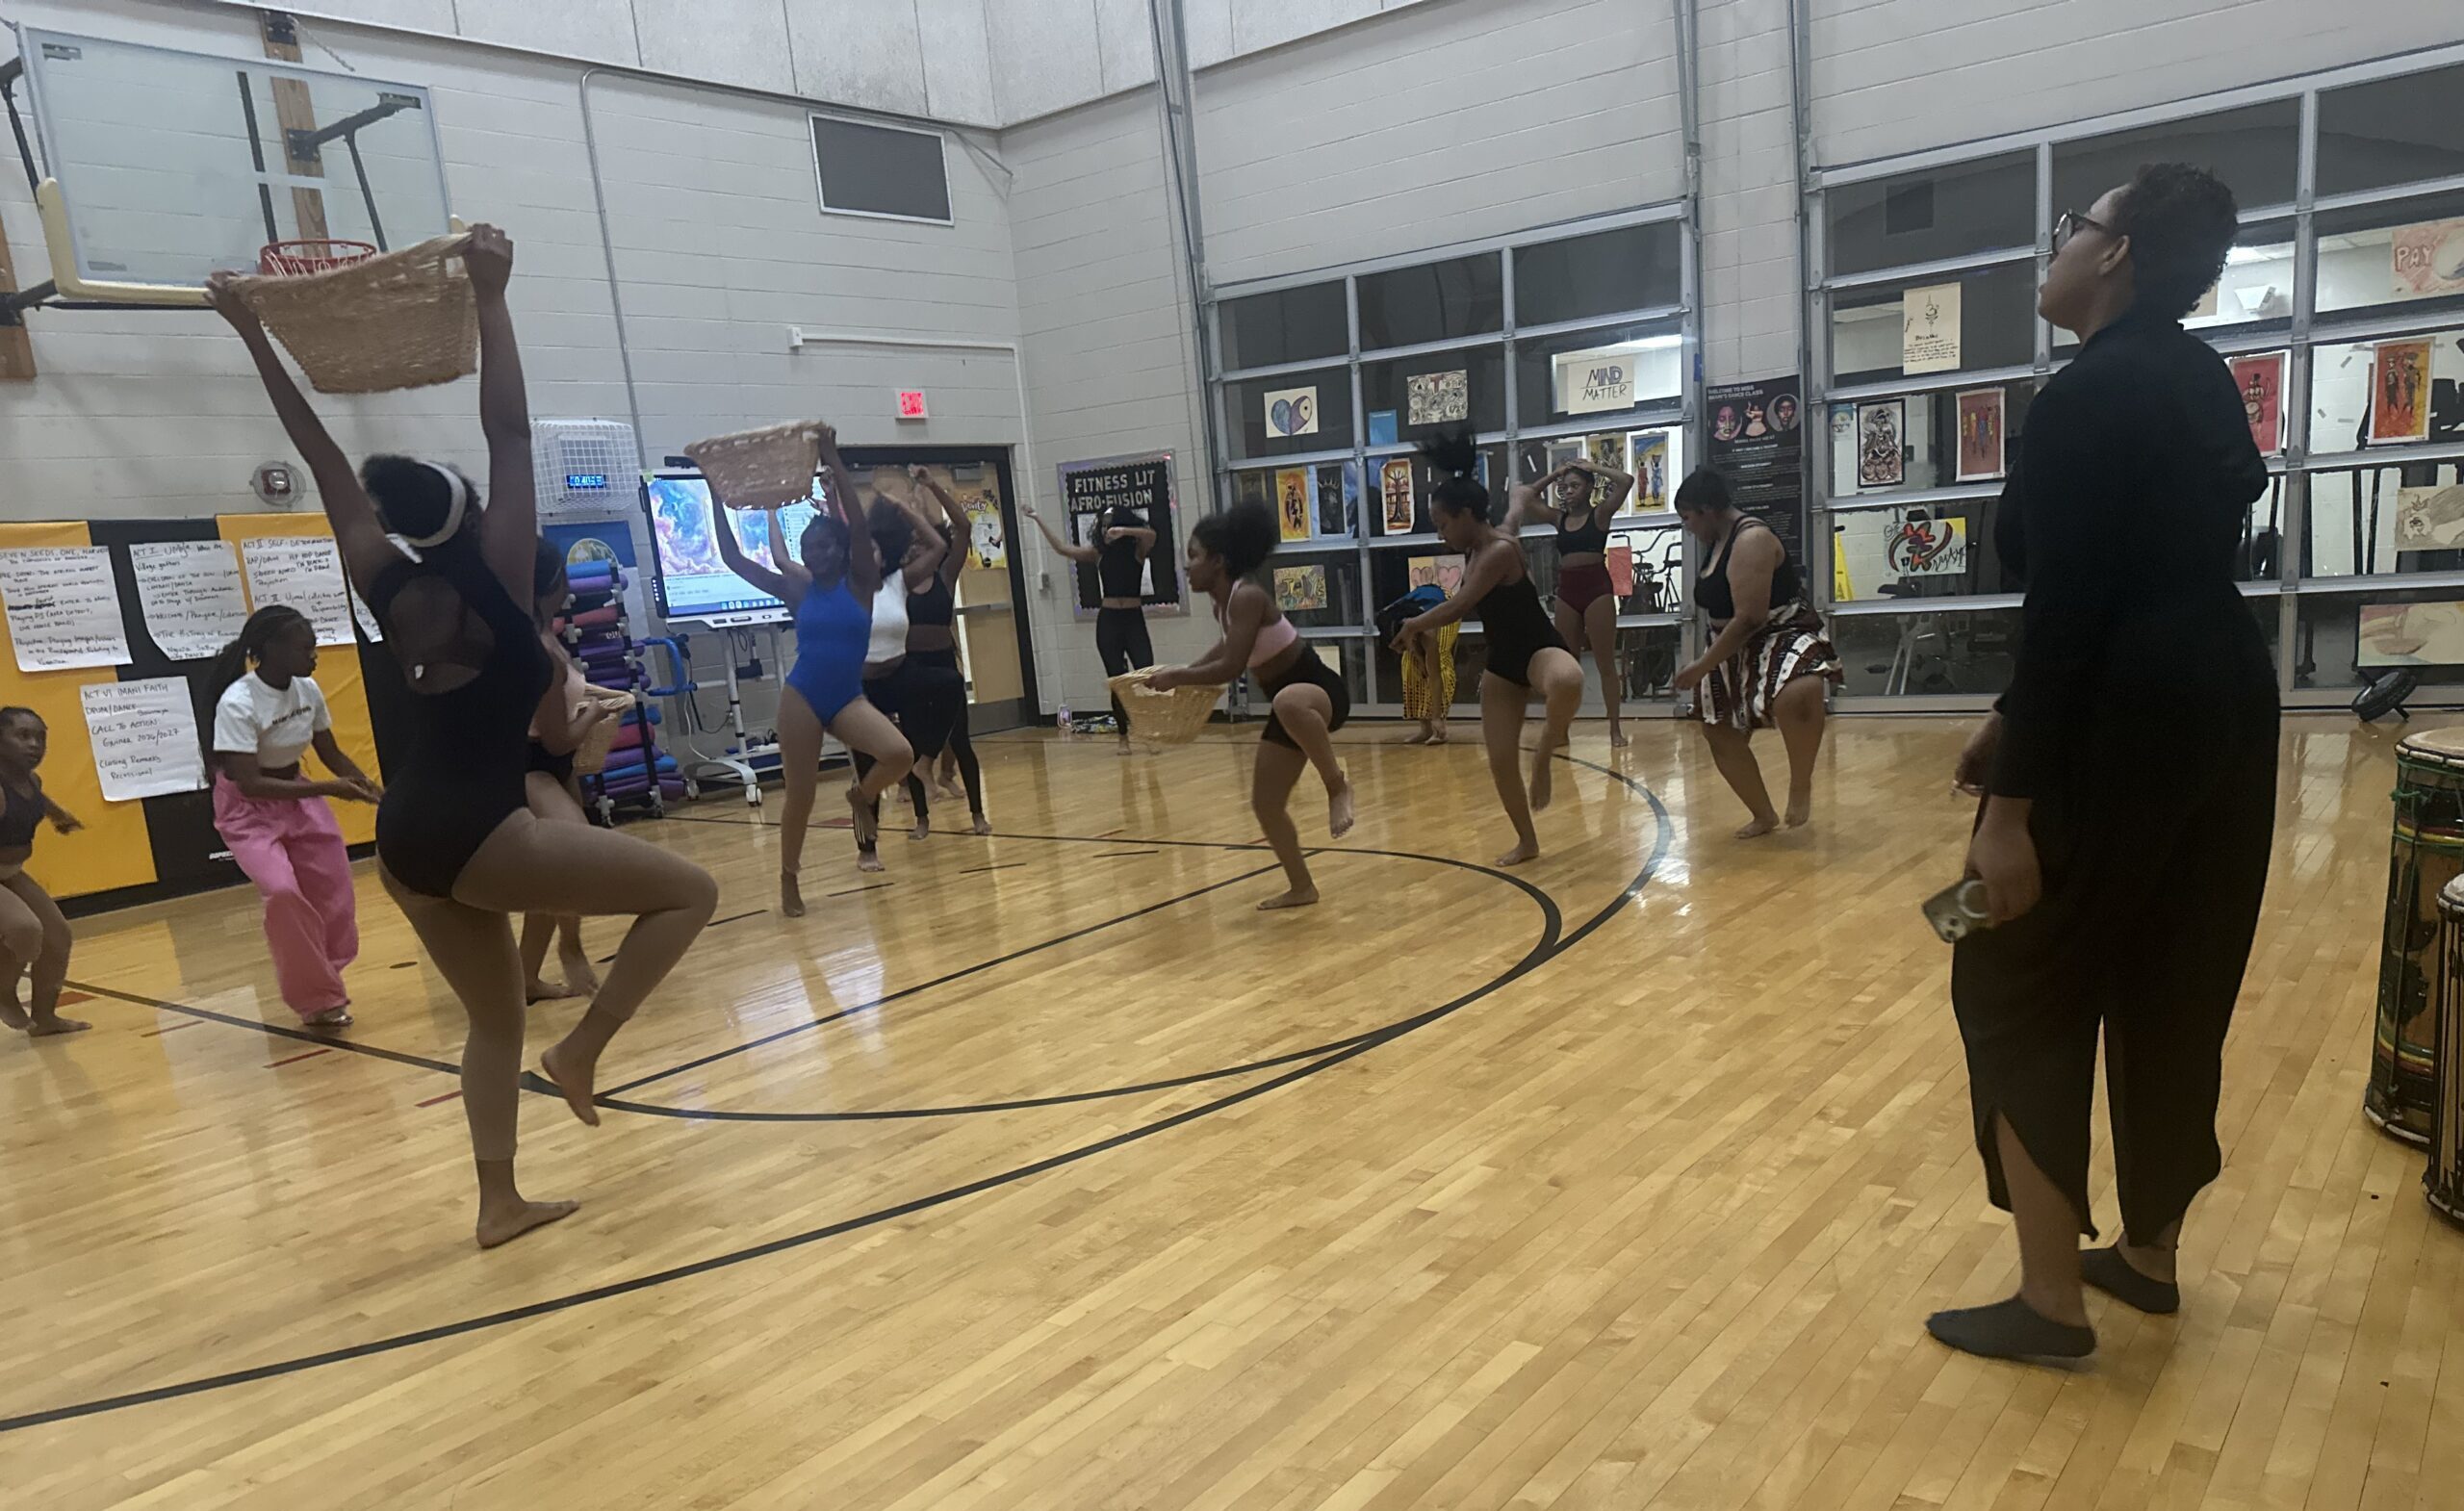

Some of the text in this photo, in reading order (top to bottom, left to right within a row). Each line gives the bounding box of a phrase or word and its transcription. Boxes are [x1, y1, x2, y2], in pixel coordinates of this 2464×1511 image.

[2395, 244, 2435, 272] PAY
[1586, 366, 1623, 387] MIND
[1582, 384, 1627, 400] MATTER
[1075, 470, 1155, 493] FITNESS LIT
[243, 541, 255, 550] ACT
[133, 548, 146, 557] ACT
[135, 562, 156, 572] Village
[254, 593, 268, 602] ACT
[84, 690, 99, 700] ACT
[117, 686, 141, 696] IMANI
[144, 683, 168, 693] FAITH
[91, 725, 115, 735] CALL
[99, 759, 127, 769] Closing
